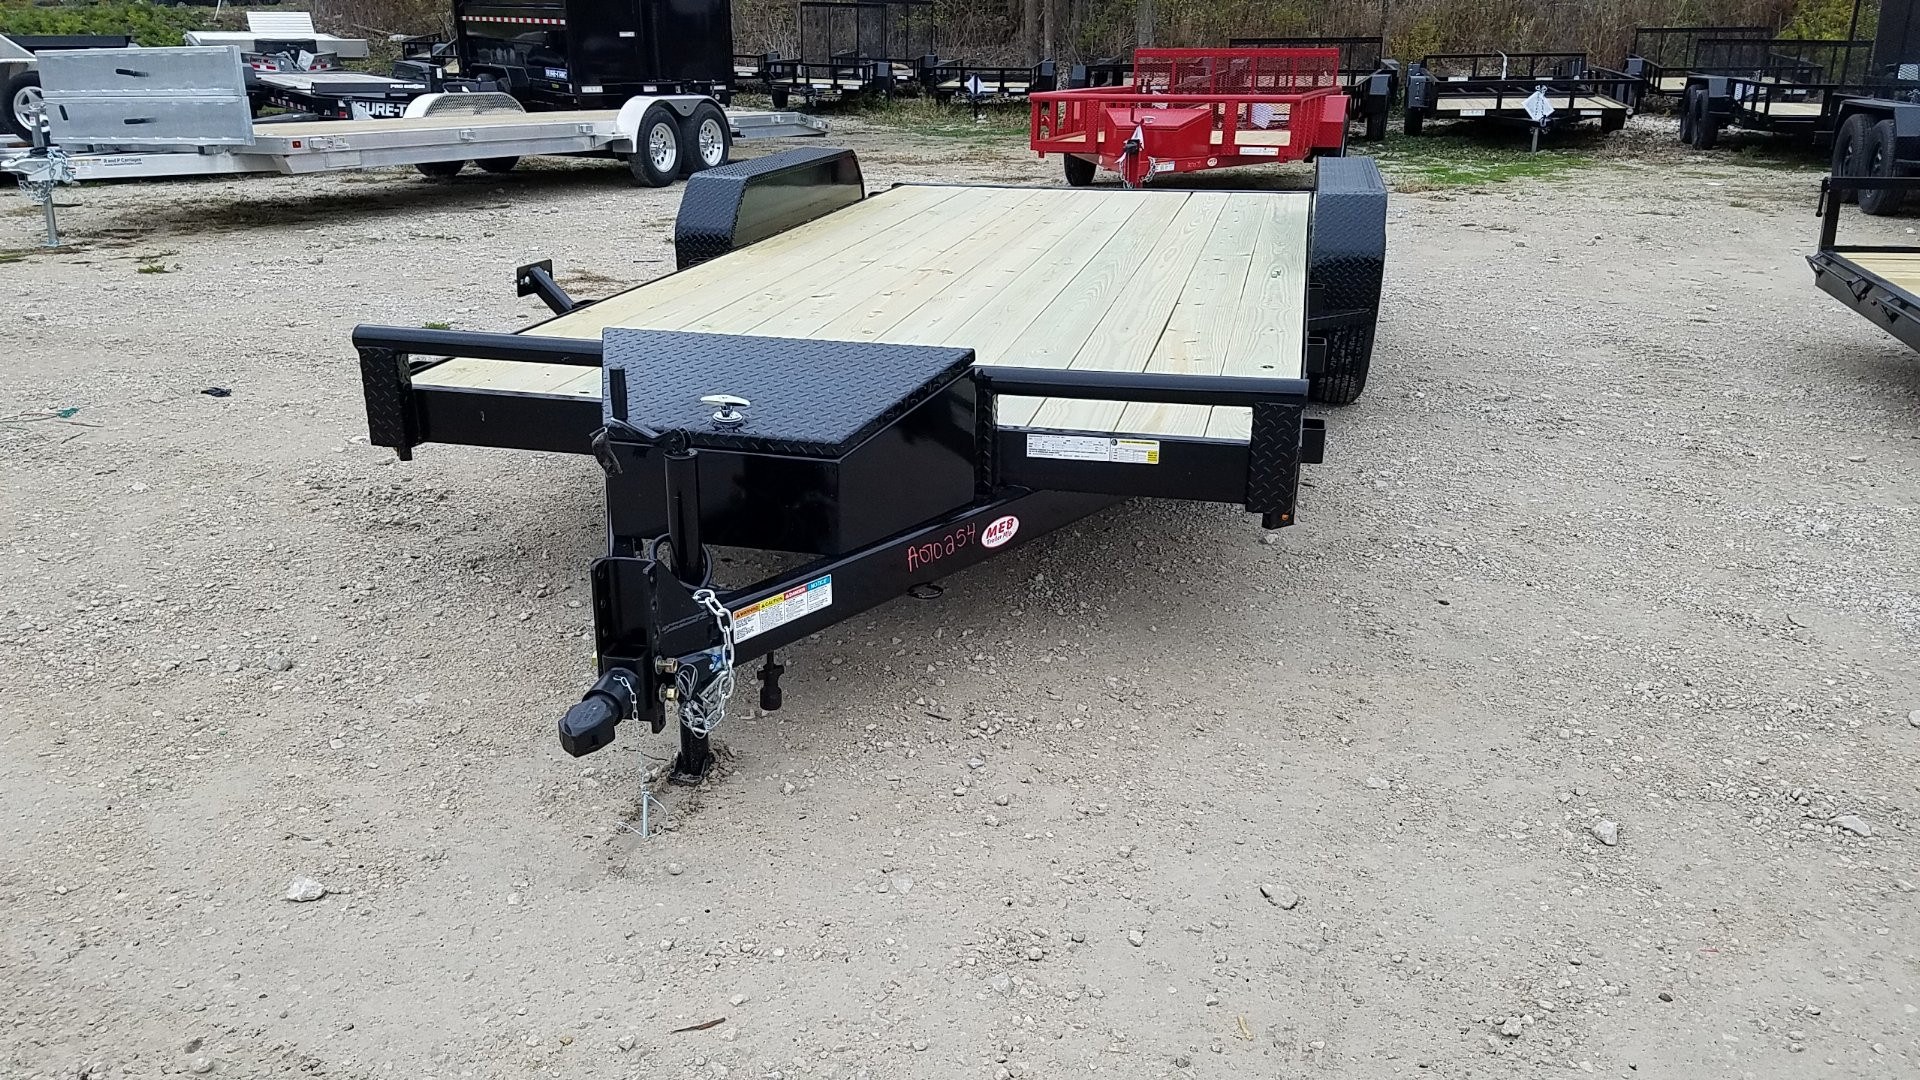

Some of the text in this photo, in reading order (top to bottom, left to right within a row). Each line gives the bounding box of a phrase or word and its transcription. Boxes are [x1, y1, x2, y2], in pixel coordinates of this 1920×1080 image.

[986, 533, 1002, 545] Trailer
[810, 578, 828, 589] NOTICE
[764, 595, 783, 608] CAUTION
